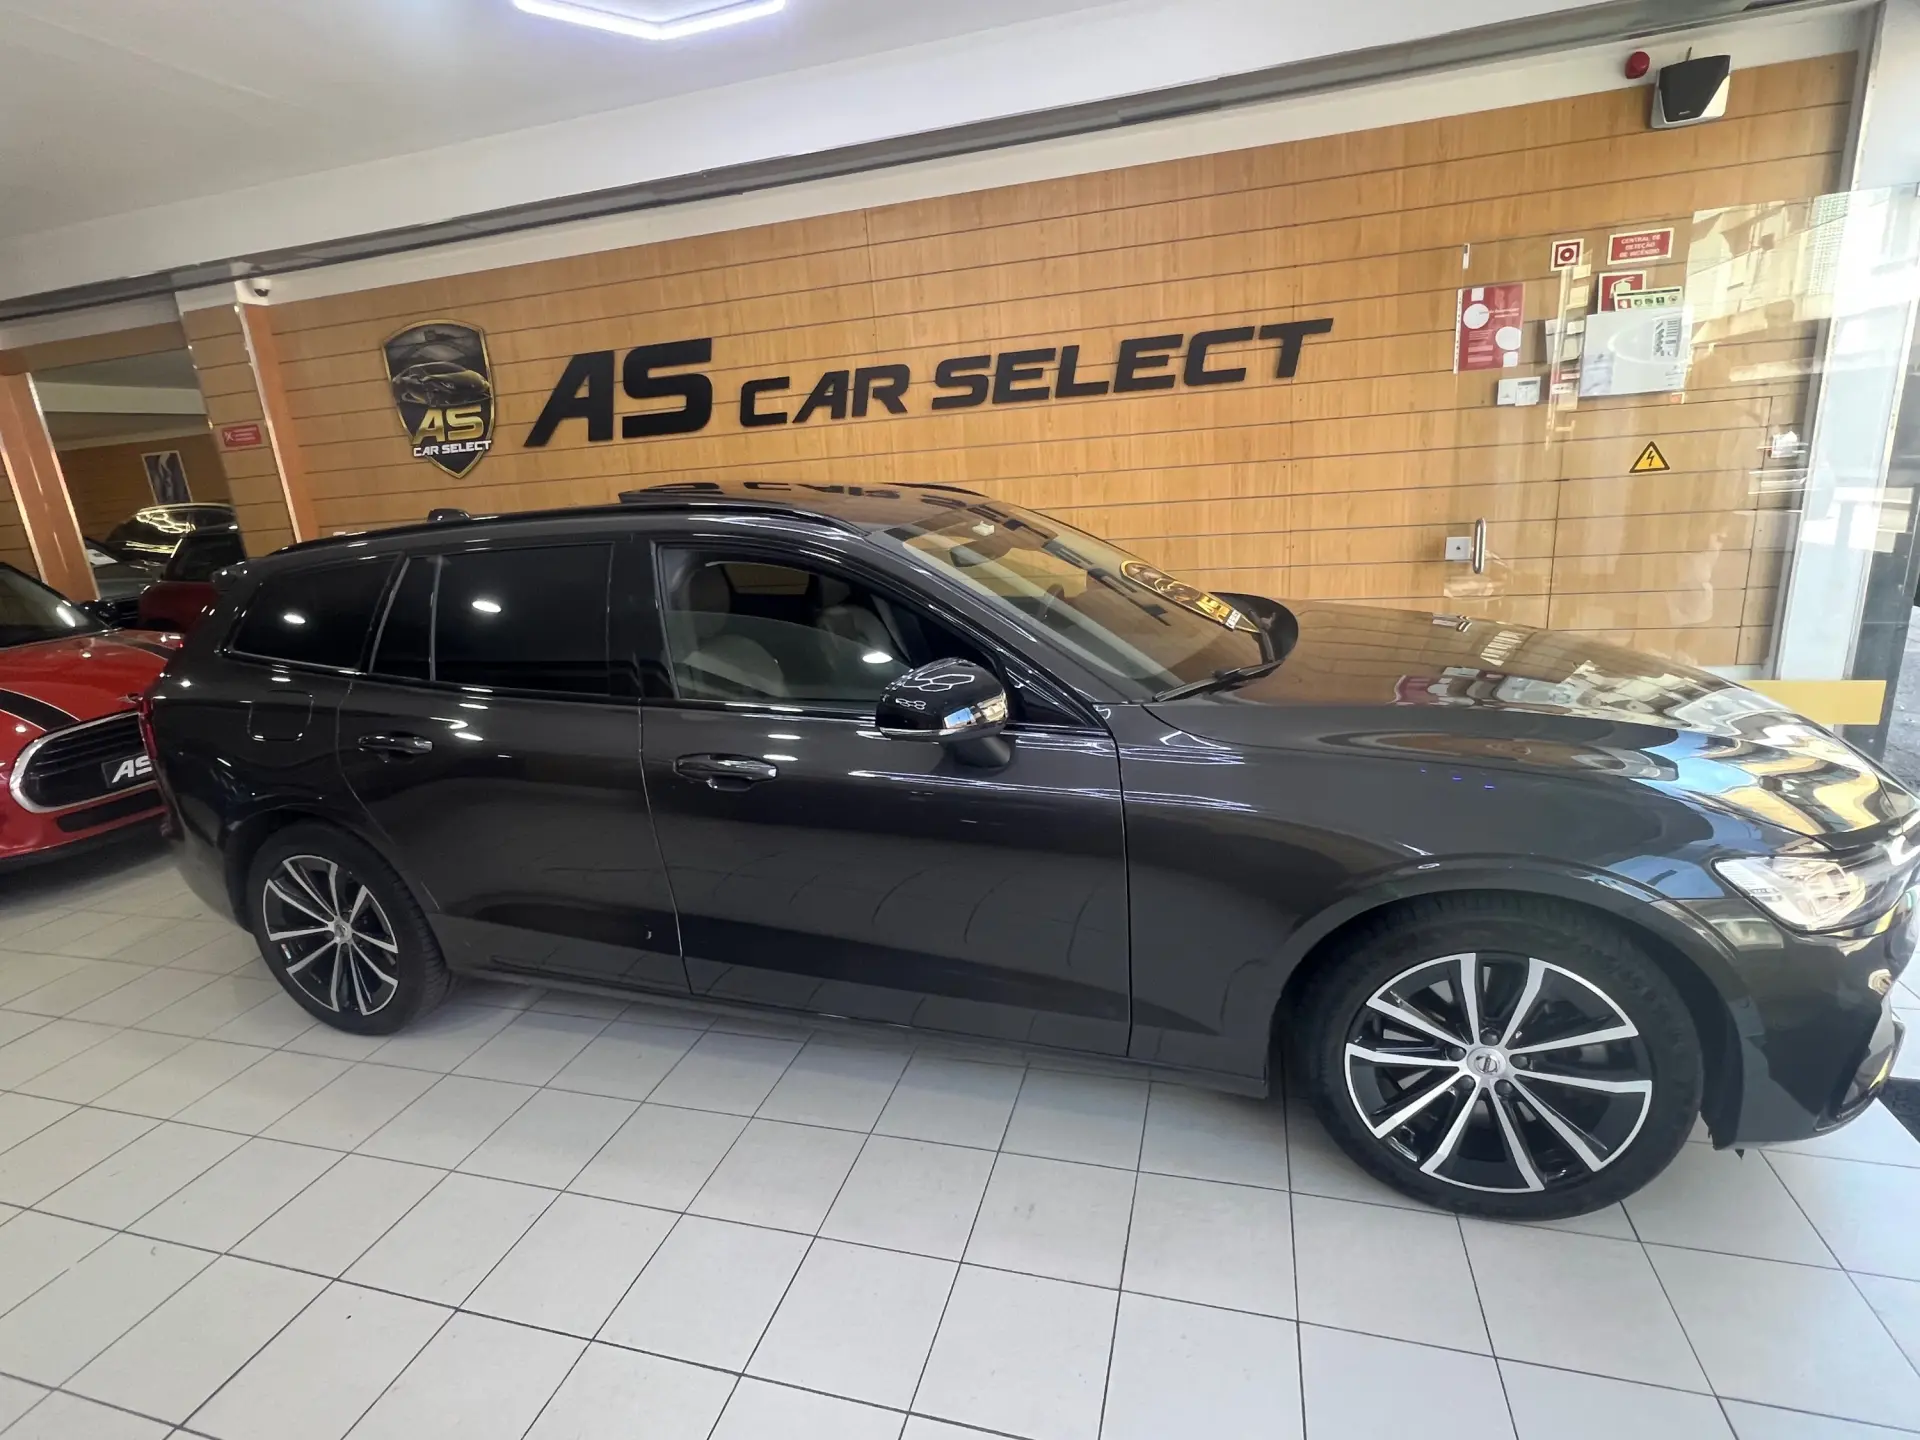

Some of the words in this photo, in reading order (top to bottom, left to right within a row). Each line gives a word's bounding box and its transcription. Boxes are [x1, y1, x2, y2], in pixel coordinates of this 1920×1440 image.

[1621, 236, 1649, 244] CENTRAL
[523, 338, 713, 448] AS
[740, 363, 911, 428] CAR
[932, 317, 1334, 411] SELECT
[412, 404, 484, 445] AS
[413, 445, 439, 457] CAR
[441, 440, 492, 454] SELECT
[111, 755, 153, 783] AS
